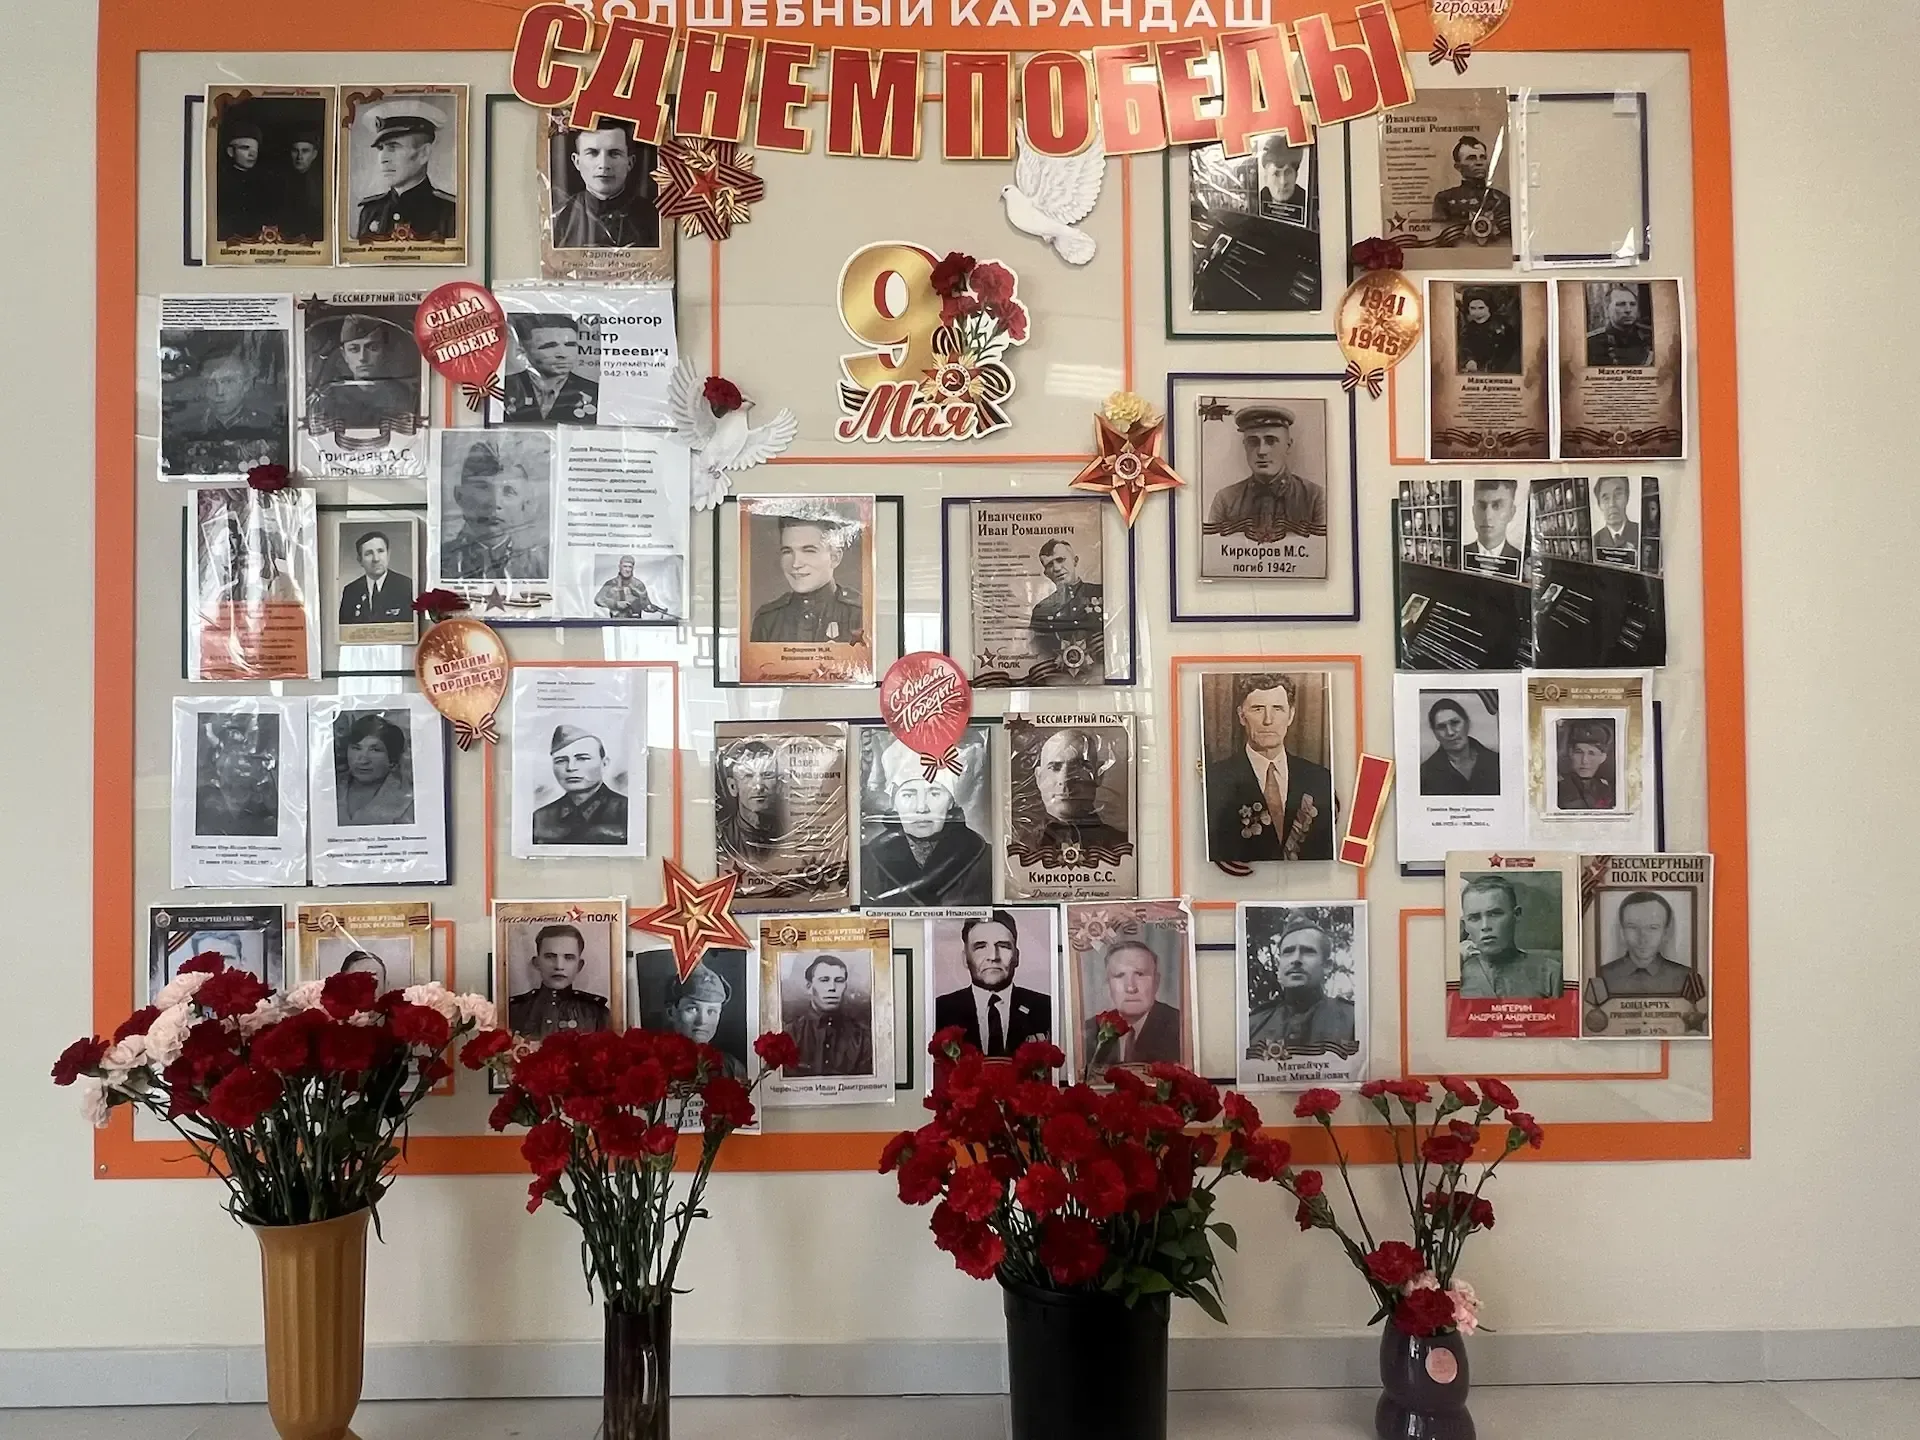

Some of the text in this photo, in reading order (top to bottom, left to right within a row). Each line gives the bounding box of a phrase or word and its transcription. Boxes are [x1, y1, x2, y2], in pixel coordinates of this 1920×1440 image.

[951, 0, 1271, 32] КАРАНДАШ
[1434, 0, 1505, 21] героям!
[510, 0, 1415, 160] С ДНЕМ ПОБЕДЫ
[332, 293, 396, 303] БЕССМЕРТНЫЙ
[1360, 287, 1406, 316] 1941
[426, 297, 485, 328] СЛАВА
[838, 240, 944, 392] 9
[435, 328, 501, 364] ПОБЕДЕ
[1348, 328, 1400, 356] 1945
[837, 382, 974, 441] Мая
[978, 510, 1042, 522] Иванченко
[978, 524, 1075, 537] Иван Романович
[1221, 545, 1309, 560] Киркоров М.С.
[1233, 562, 1297, 574] погиб 1942г
[434, 654, 491, 676] ПОМНИМ!
[432, 669, 502, 694] ГОРДИМСЯ!
[894, 675, 958, 733] Победы!
[1036, 713, 1097, 724] БЕССМЕРТНЫЙ
[1611, 858, 1705, 870] БЕССМЕРТНЫЙ
[1029, 872, 1116, 884] Киркоров С.С.
[1612, 871, 1705, 884] ПОЛК РОССИИ
[587, 913, 619, 923] ПОЛК
[866, 909, 988, 917] Савченко Евгения Ивановна
[1620, 1001, 1670, 1010] БОНДАРЧУК
[1277, 1061, 1330, 1073] Матвейчук
[1257, 1073, 1287, 1083] Павел
